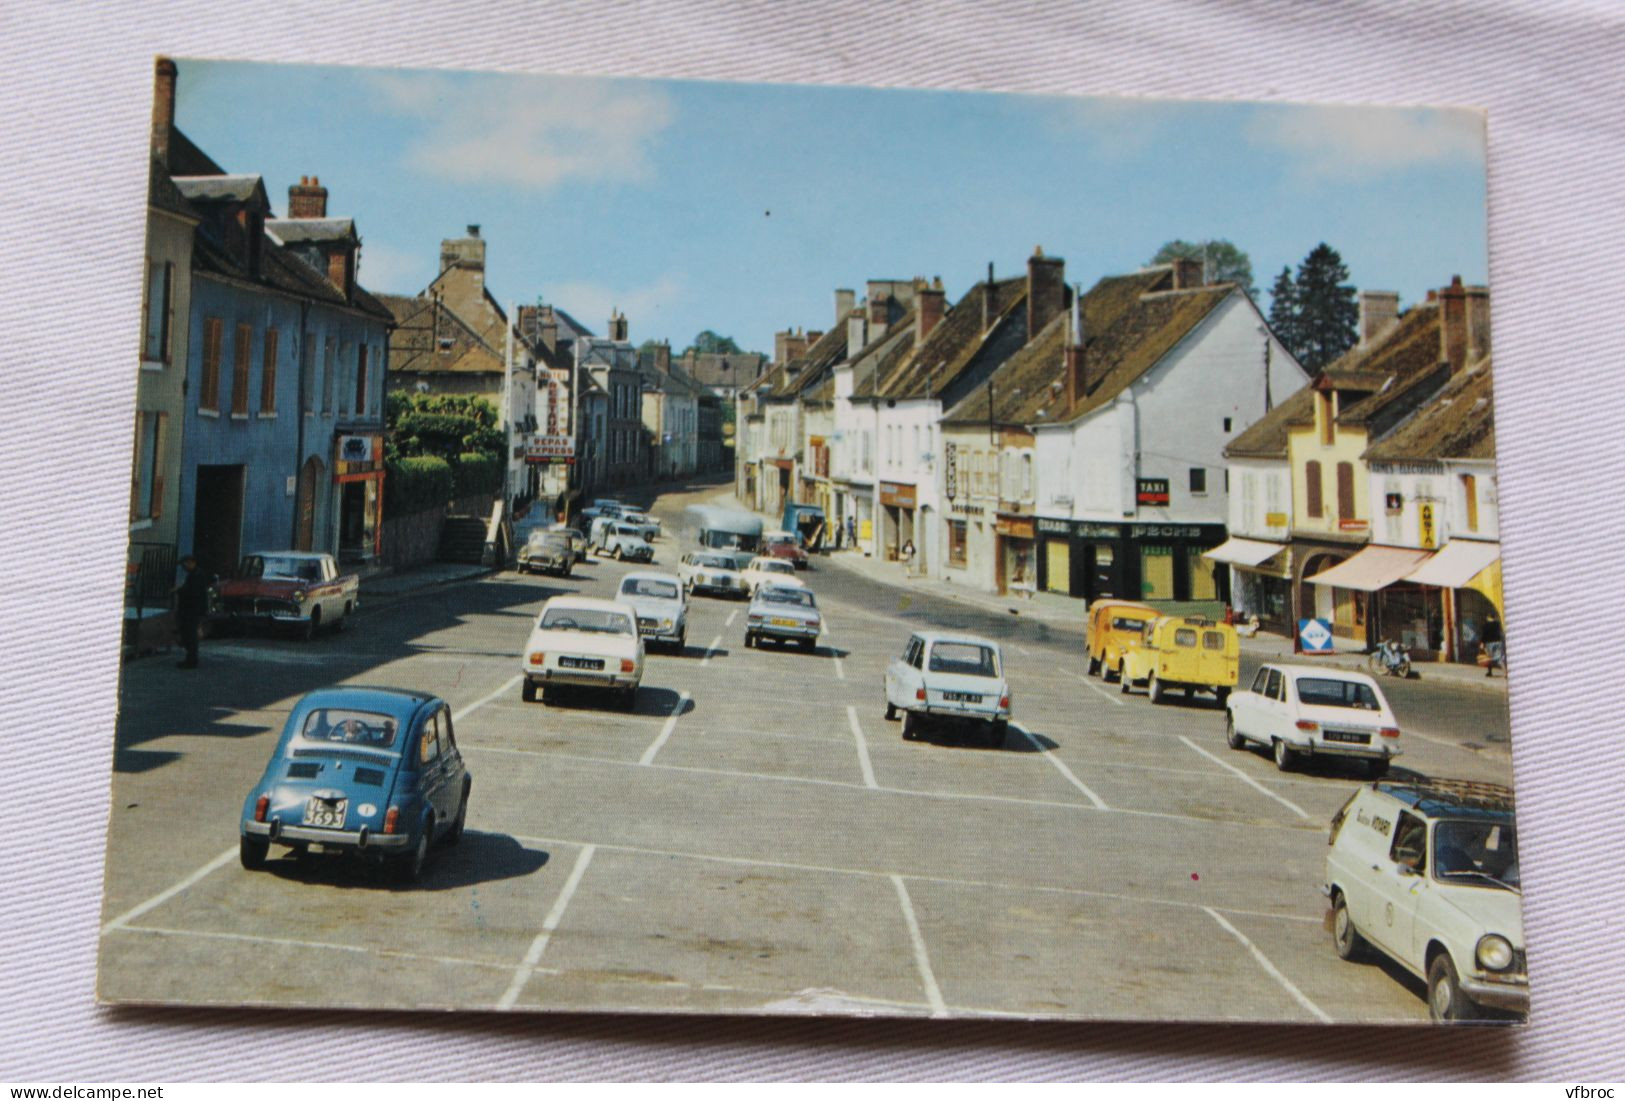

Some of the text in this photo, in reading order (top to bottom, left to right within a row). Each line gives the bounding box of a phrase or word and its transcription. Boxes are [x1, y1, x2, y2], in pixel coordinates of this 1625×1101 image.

[533, 438, 568, 446] REPAS
[527, 447, 574, 455] EXPRESS
[1140, 482, 1165, 493] TAXI
